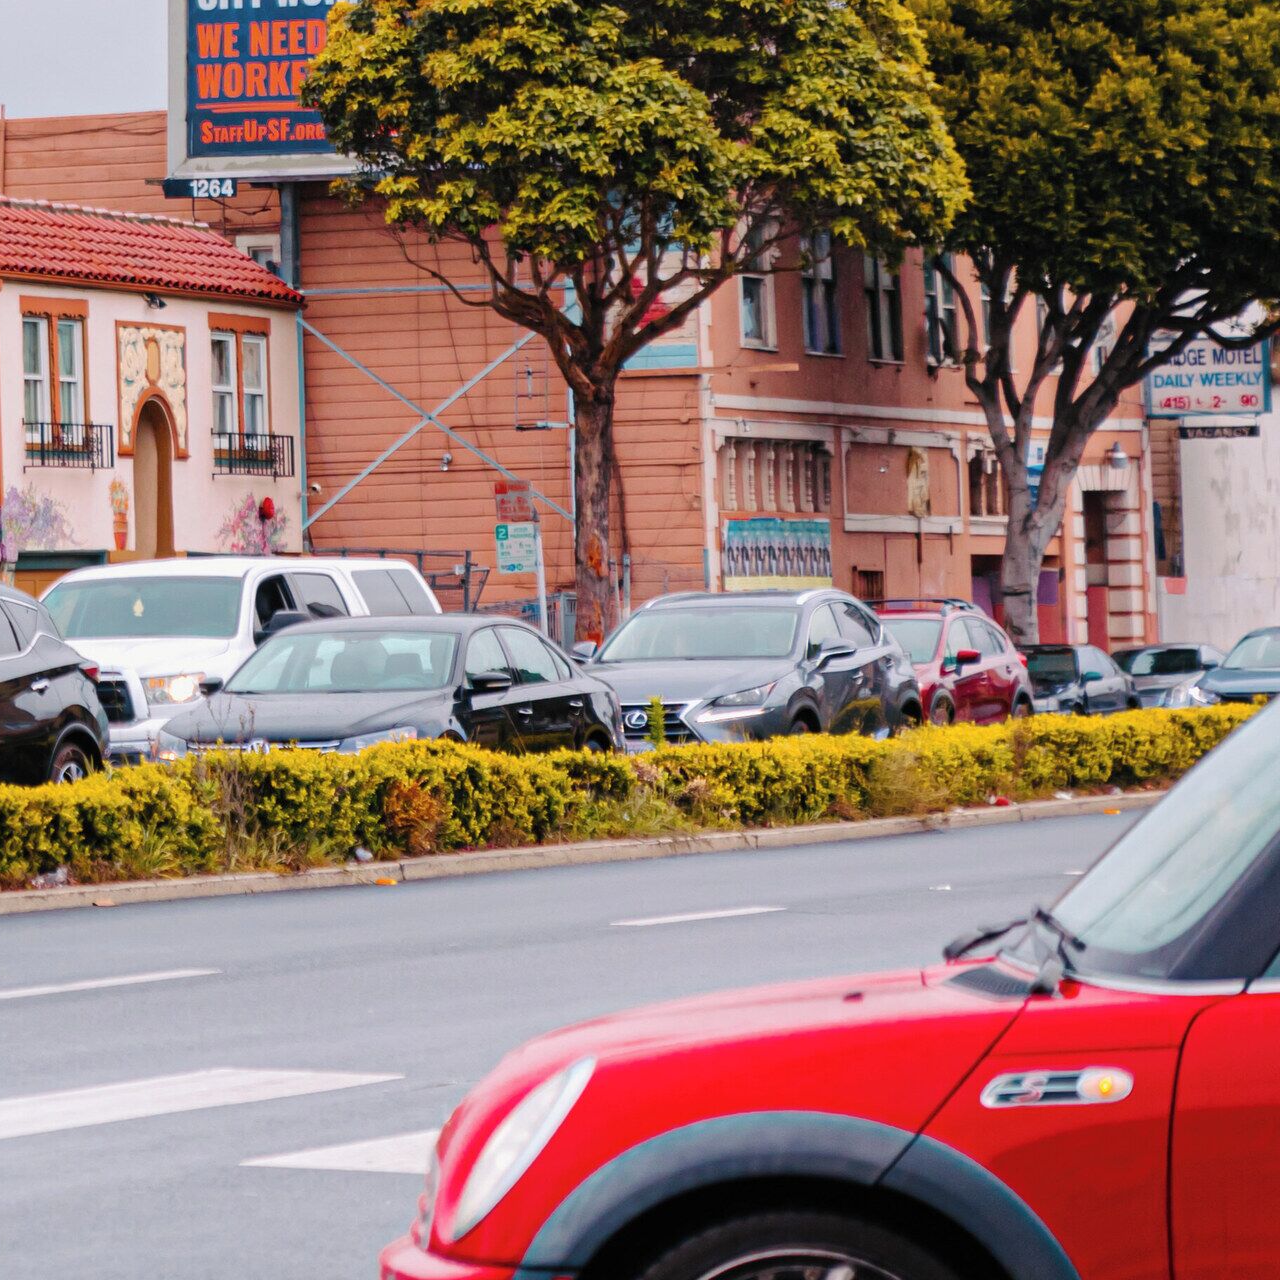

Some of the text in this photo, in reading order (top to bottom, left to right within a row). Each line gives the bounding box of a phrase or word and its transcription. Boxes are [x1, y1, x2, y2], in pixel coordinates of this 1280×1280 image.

[196, 19, 327, 59] WE NEED
[196, 60, 307, 99] WORKE
[190, 178, 234, 198] 1264
[1212, 347, 1262, 365] MOTEL
[1153, 371, 1263, 388] DAILY WEEKLY
[1160, 396, 1190, 411] (415)
[498, 528, 507, 539] 2
